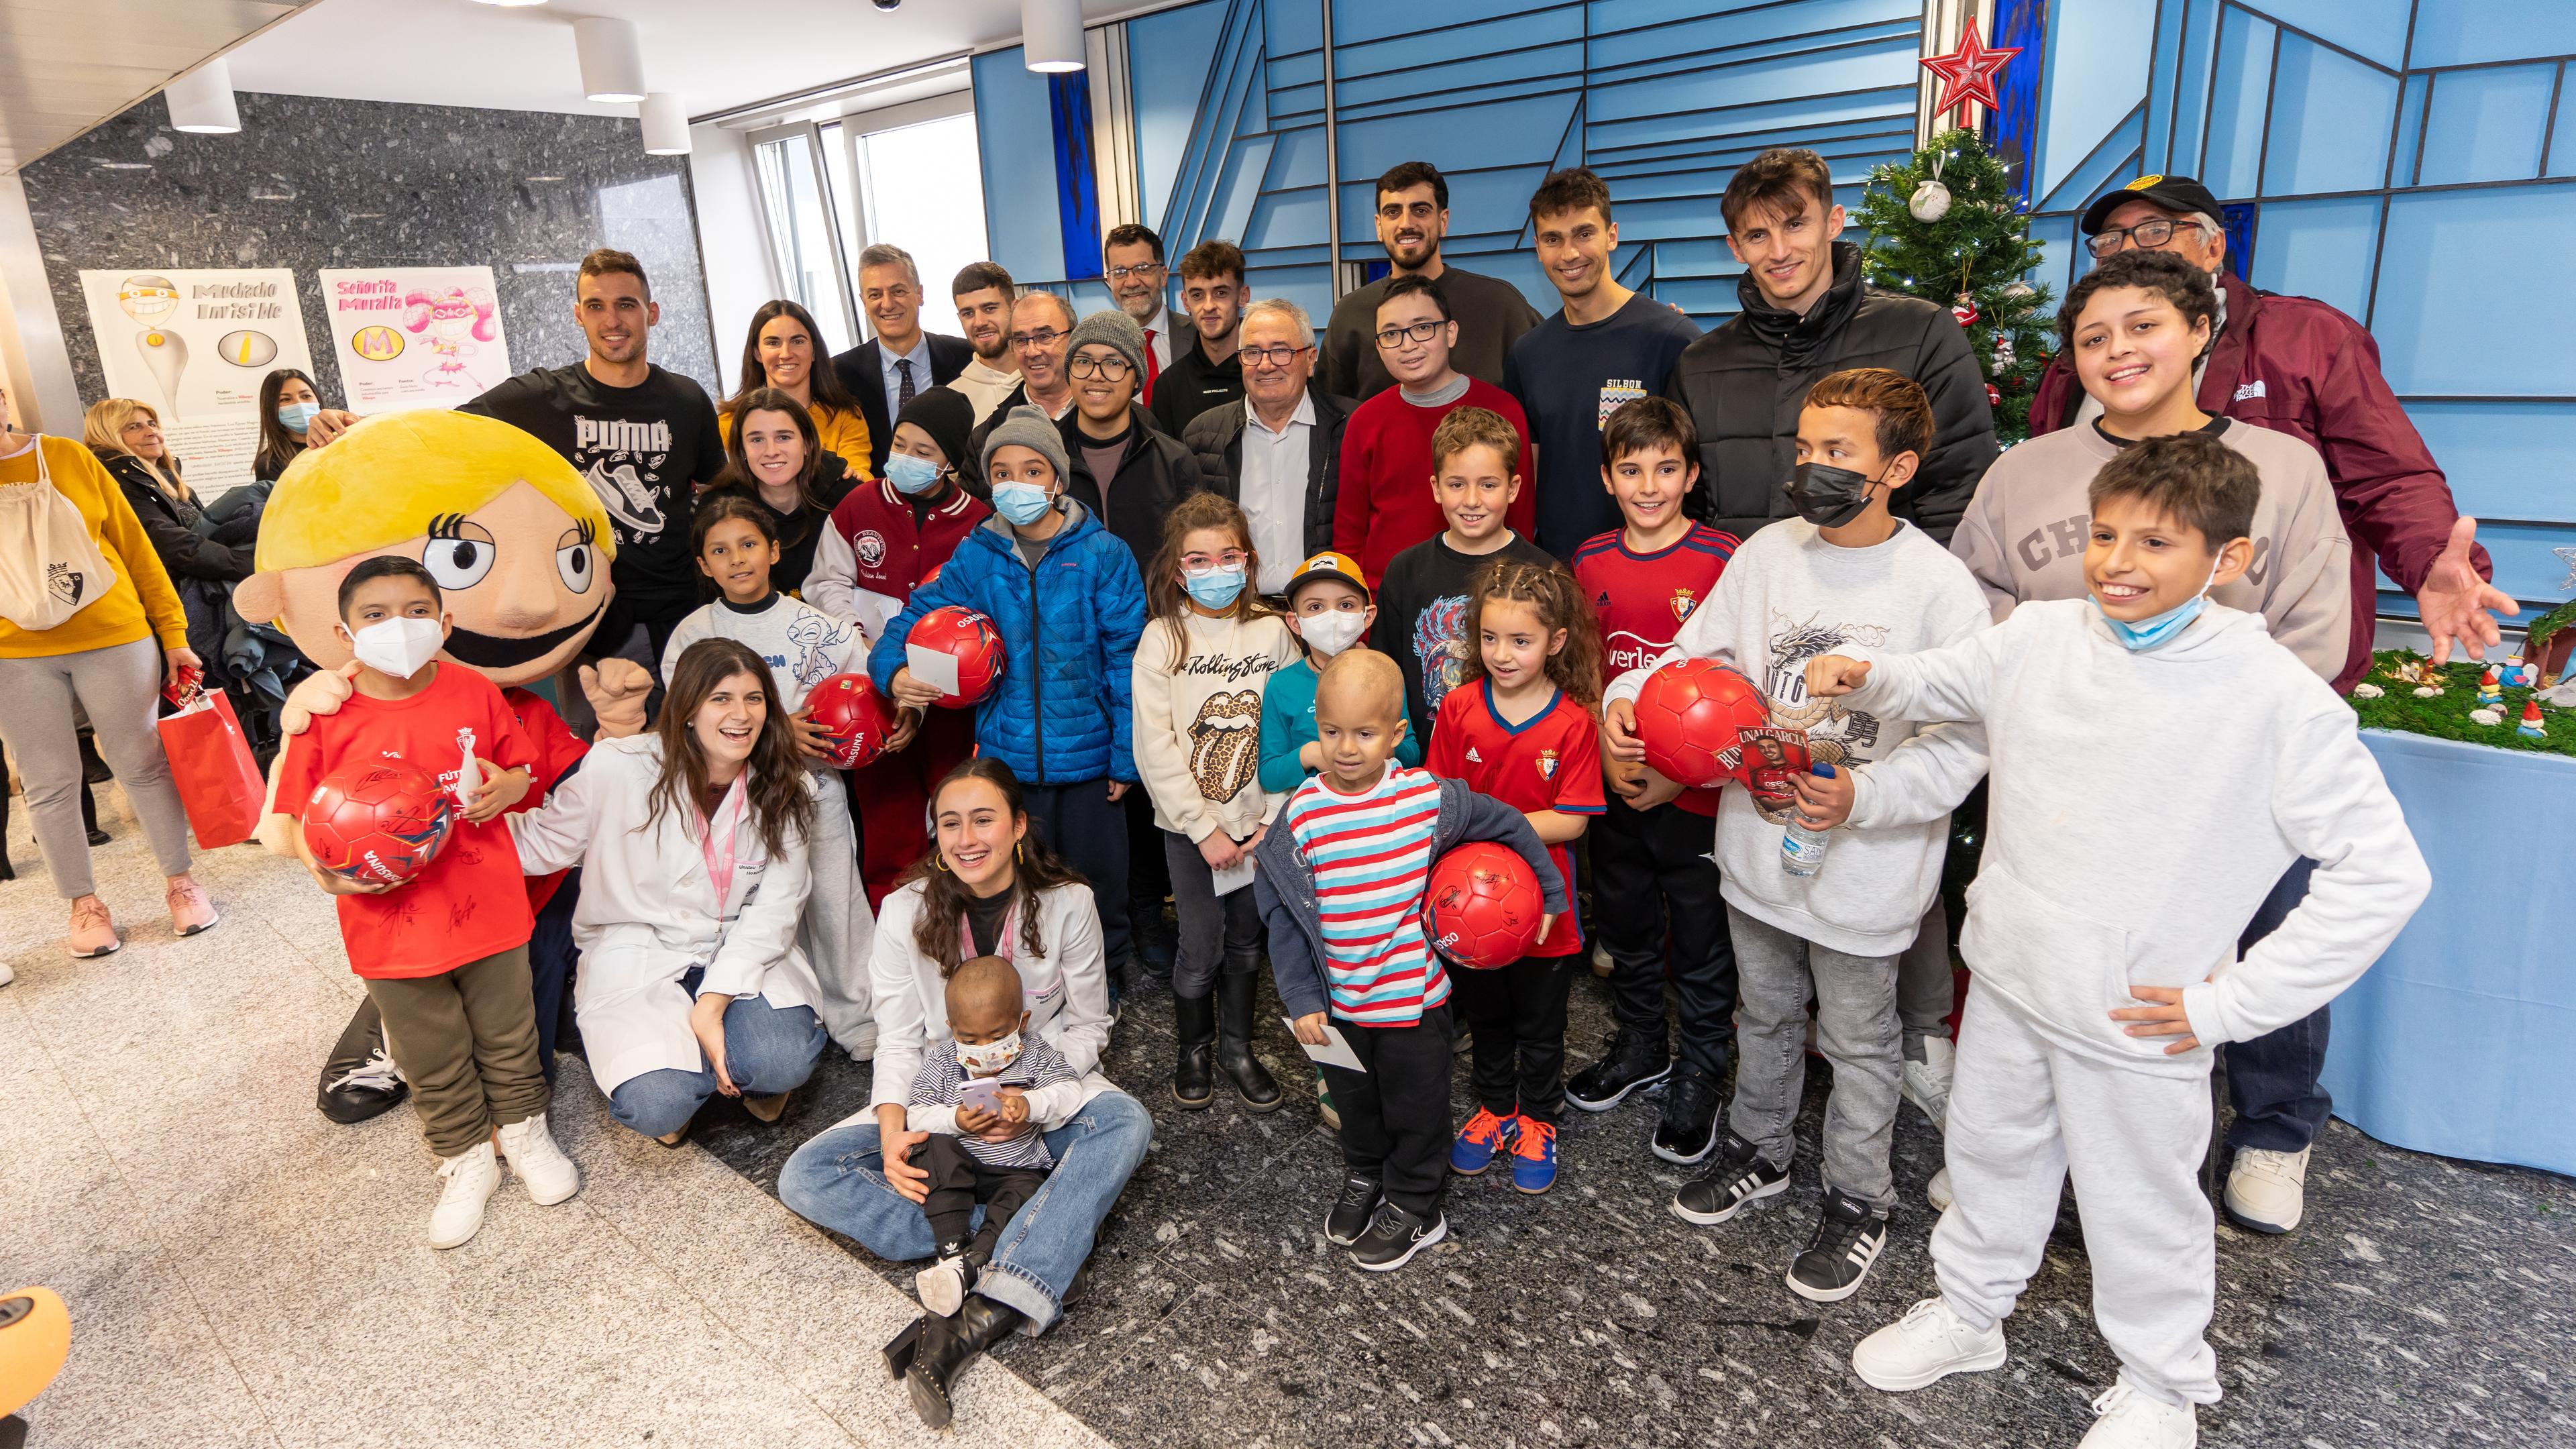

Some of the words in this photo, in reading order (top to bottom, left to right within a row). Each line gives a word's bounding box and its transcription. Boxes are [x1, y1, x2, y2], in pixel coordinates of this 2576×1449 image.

[193, 282, 278, 299] Muchacho
[337, 280, 398, 295] Señorita
[197, 303, 282, 319] Invisible
[339, 295, 402, 311] Muralla
[363, 328, 394, 356] M
[1607, 379, 1642, 389] SILBON
[577, 419, 669, 452] PUMA
[1609, 647, 1657, 669] verle
[1189, 653, 1242, 683] Rolling
[844, 732, 865, 767] OSASUNA
[1466, 755, 1483, 764] adidas
[1842, 1201, 1860, 1214] adidas
